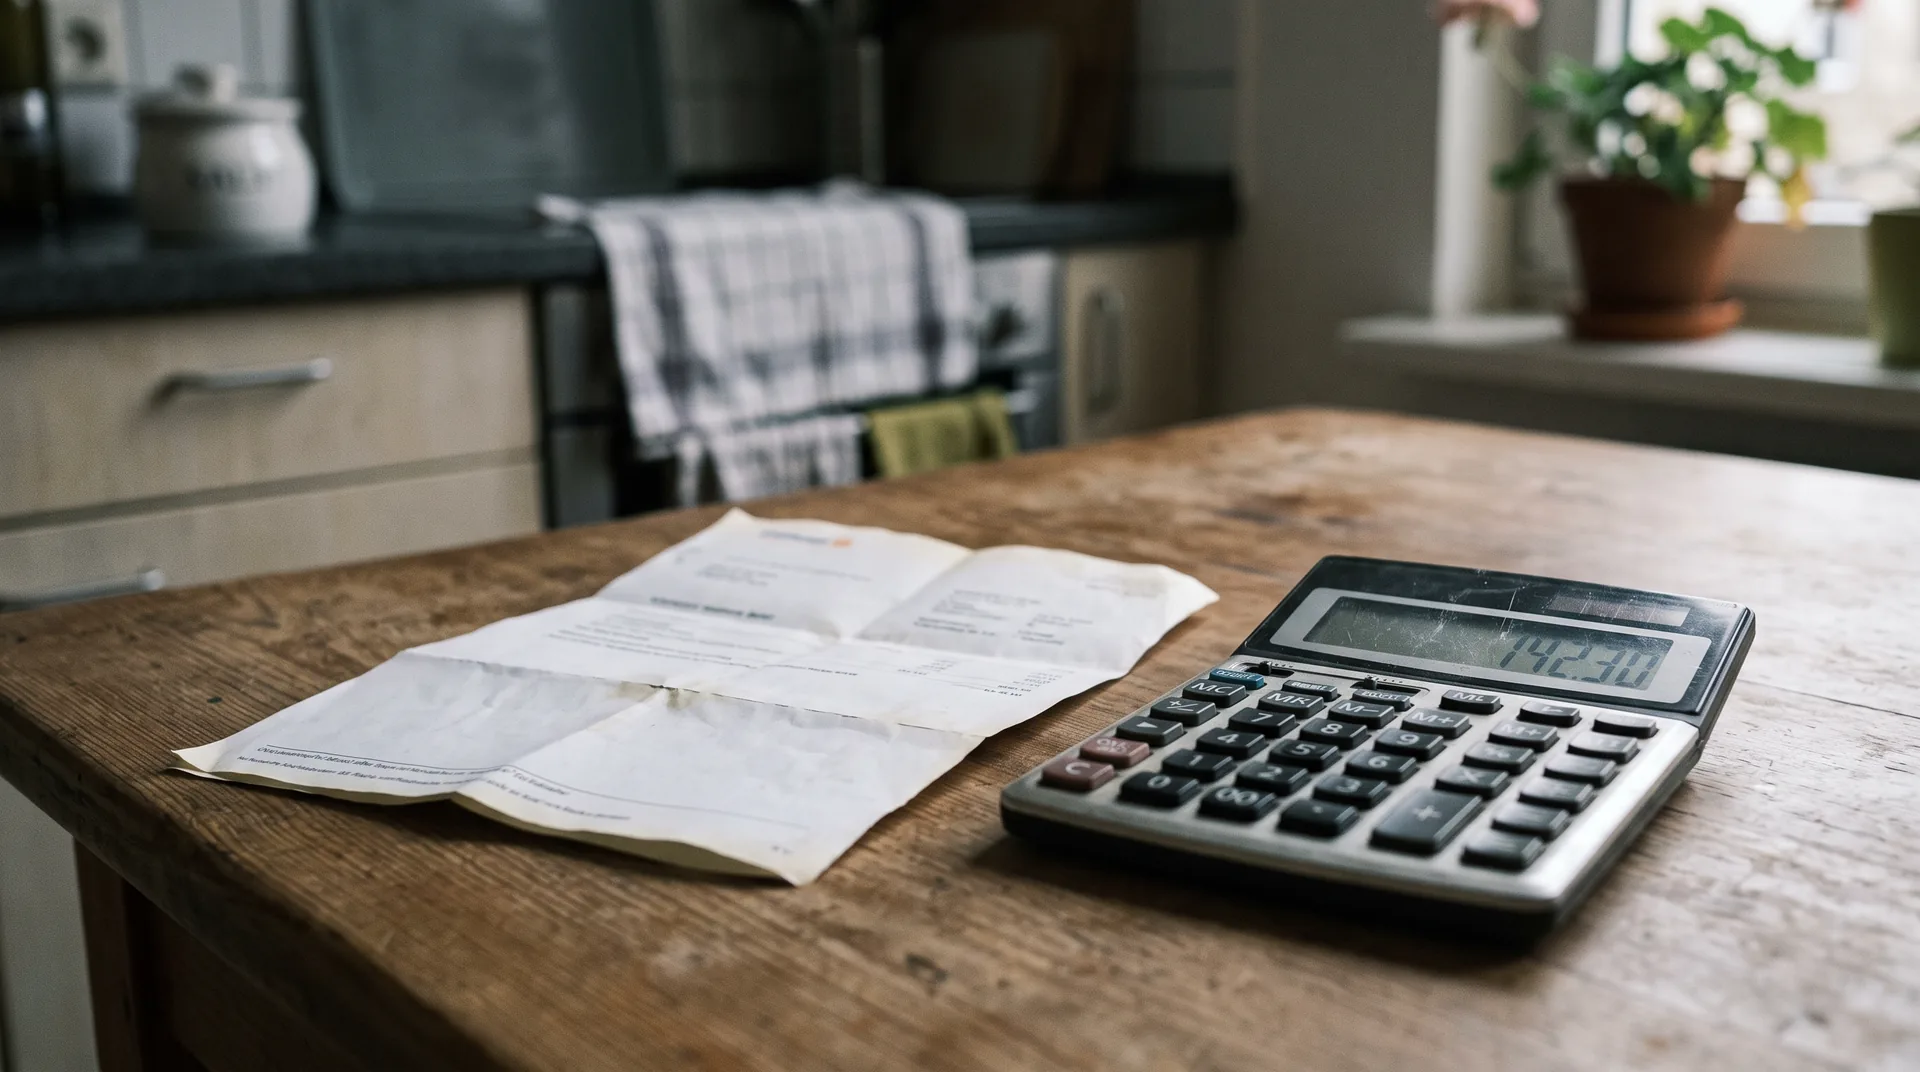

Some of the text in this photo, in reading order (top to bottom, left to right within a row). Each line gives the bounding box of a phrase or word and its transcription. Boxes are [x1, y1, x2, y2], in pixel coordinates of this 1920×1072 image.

[1191, 682, 1233, 694] MC
[1250, 712, 1274, 723] 7
[1411, 711, 1454, 724] M+
[1320, 723, 1344, 735] 8
[1216, 732, 1240, 744] 4
[1396, 733, 1420, 746] 9
[1291, 743, 1317, 756] 5
[1188, 754, 1204, 767] 1
[1367, 755, 1391, 768] 6
[1065, 761, 1091, 775] C
[1257, 765, 1283, 779] 2
[1335, 778, 1362, 793] 3
